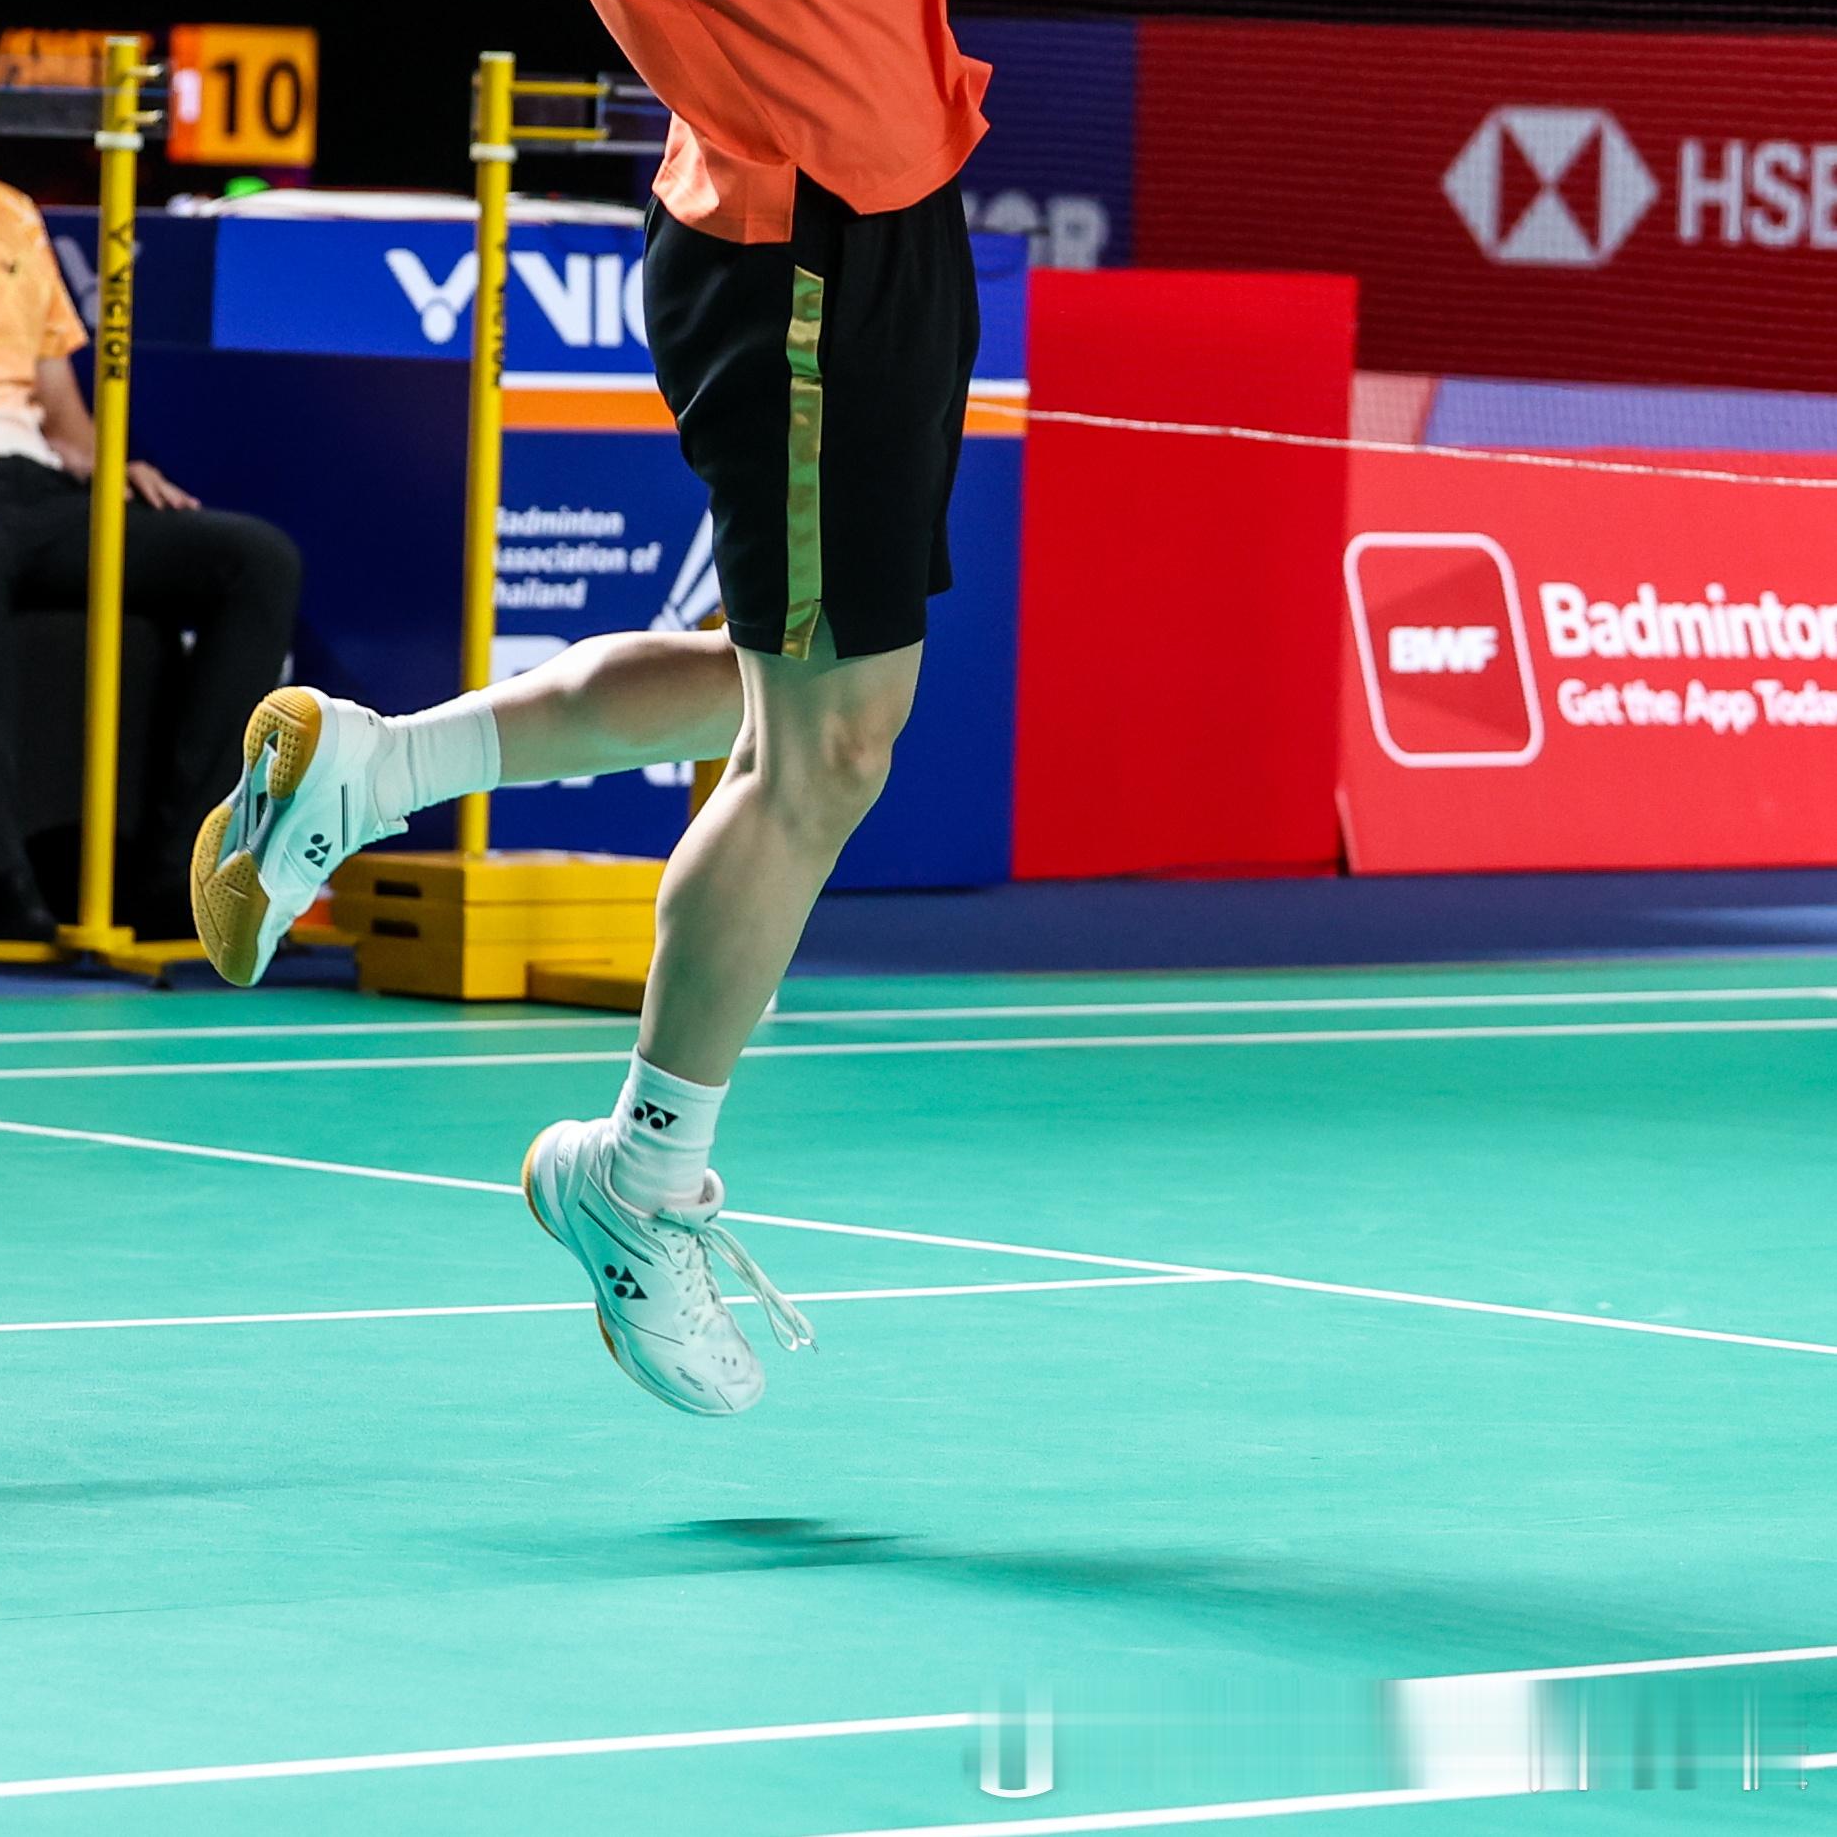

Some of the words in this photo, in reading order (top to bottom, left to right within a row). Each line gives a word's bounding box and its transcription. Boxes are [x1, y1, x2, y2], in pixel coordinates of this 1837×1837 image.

[212, 58, 302, 138] 10
[495, 541, 628, 574] ssociation
[629, 541, 662, 574] of
[494, 576, 588, 609] hailand
[1388, 626, 1499, 673] BWF
[1557, 678, 1623, 726] Get
[1621, 678, 1682, 726] the
[1684, 678, 1757, 735] App
